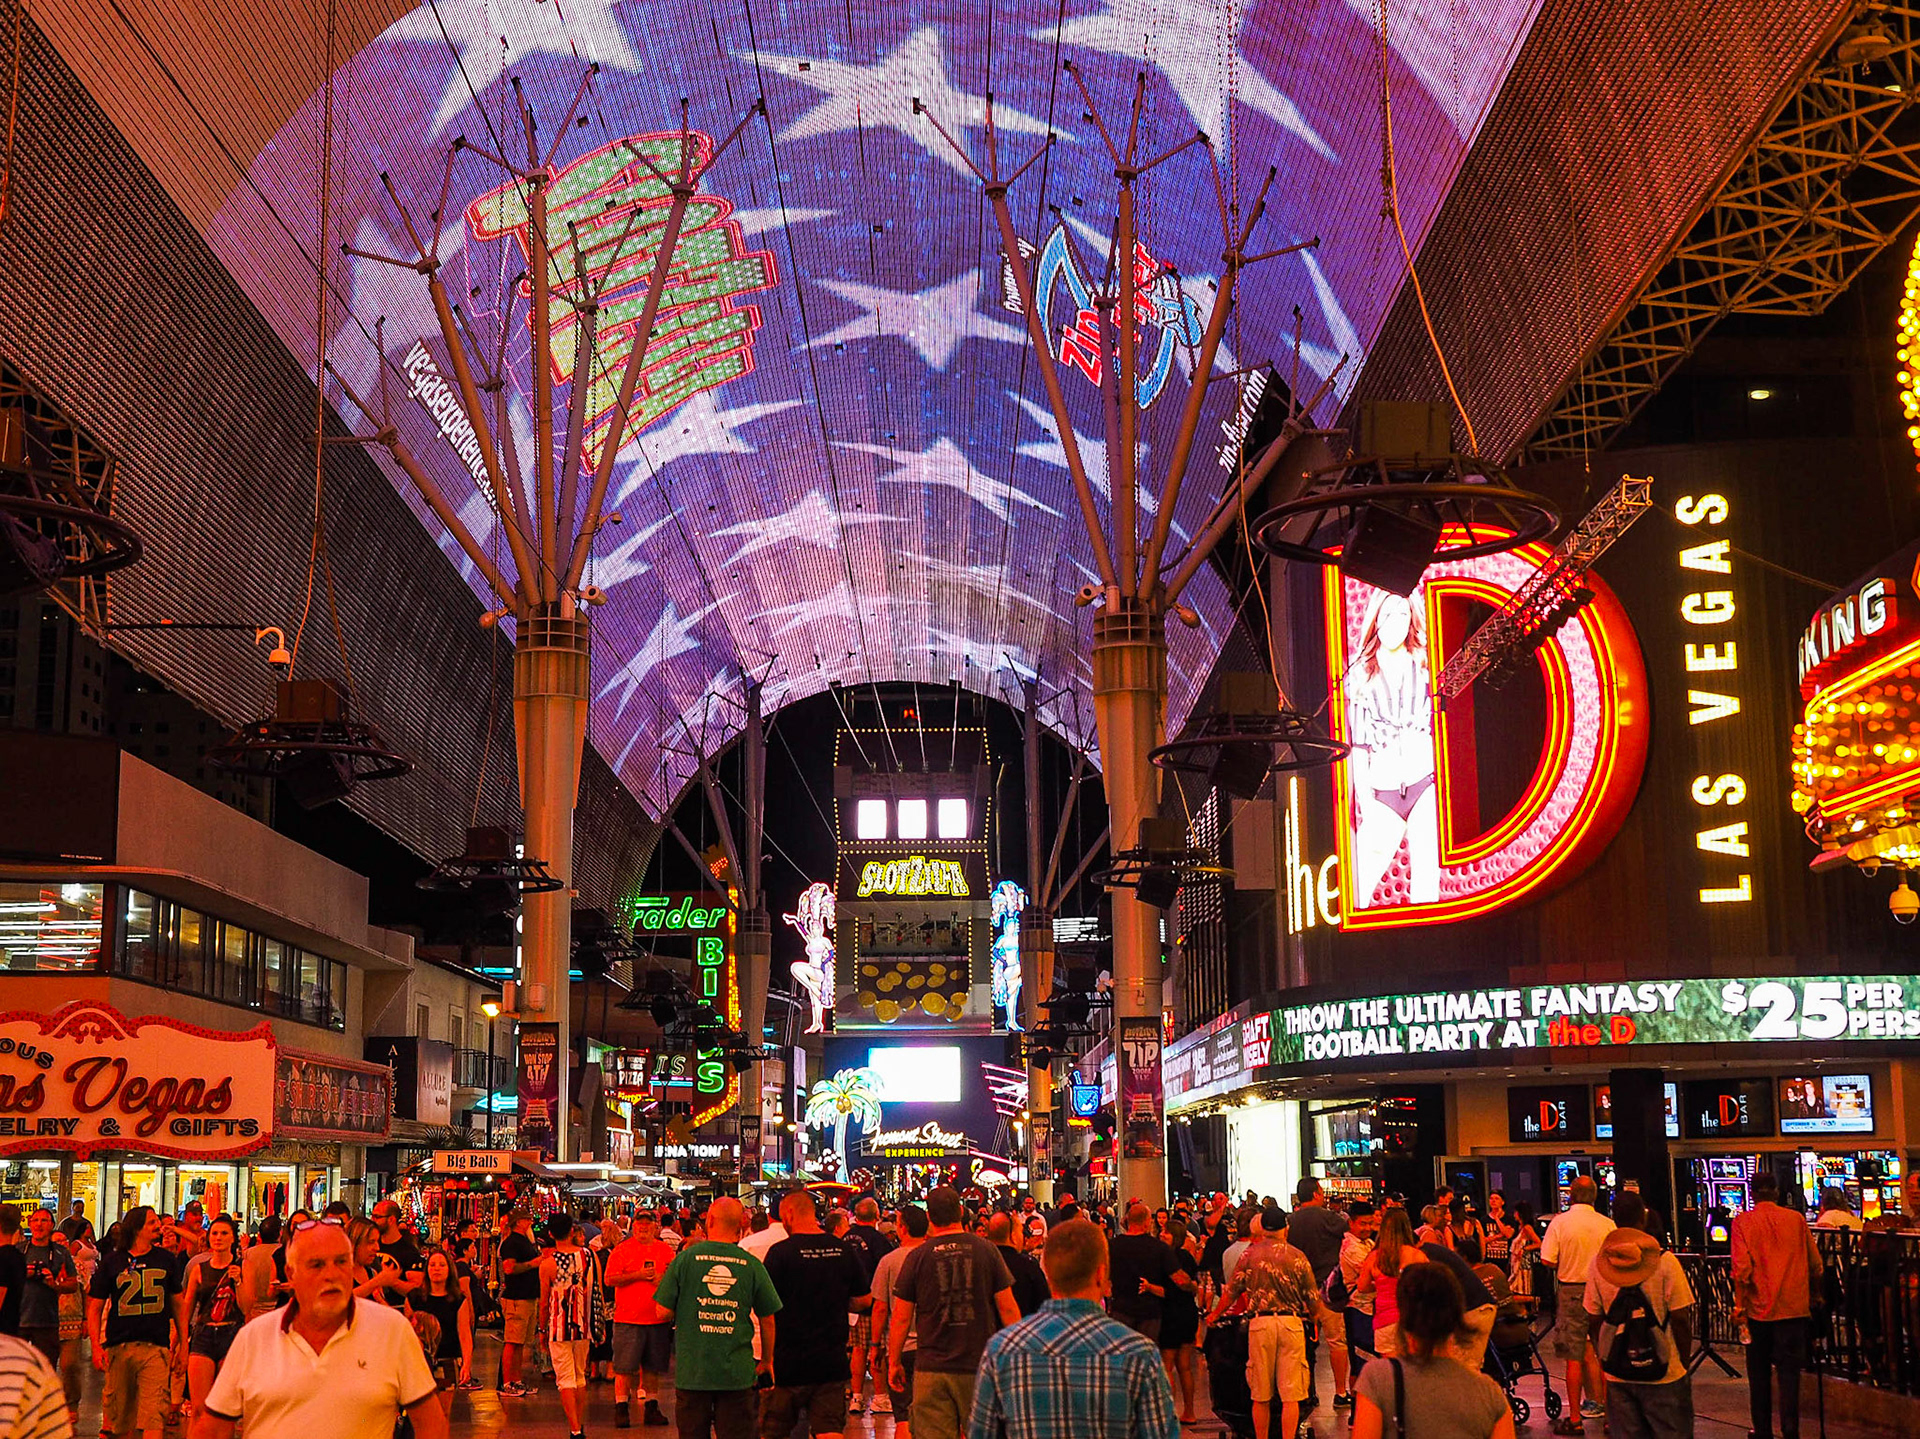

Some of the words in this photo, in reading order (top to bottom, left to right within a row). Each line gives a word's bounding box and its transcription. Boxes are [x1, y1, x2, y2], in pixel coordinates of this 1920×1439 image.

[1675, 493, 1743, 725] VEGAS
[1284, 776, 1341, 935] the
[1322, 521, 1650, 933] D
[1690, 772, 1753, 903] LAS
[1284, 1003, 1345, 1036] THROW
[1349, 1000, 1389, 1027] THE
[1396, 990, 1521, 1024] ULTIMATE
[1531, 982, 1682, 1016] FANTASY
[1721, 981, 1848, 1039] $25
[1847, 982, 1903, 1009] PER
[1304, 1027, 1403, 1060] FOOTBALL
[1409, 1022, 1493, 1052] PARTY
[1502, 1020, 1539, 1048] AT
[1548, 1016, 1601, 1047] the
[1610, 1015, 1637, 1045] D
[63, 1056, 234, 1137] Vegas
[618, 1070, 644, 1087] PIZZA
[98, 1118, 120, 1136] &
[169, 1118, 259, 1136] GIFTS
[1524, 1116, 1540, 1133] the
[1540, 1101, 1559, 1131] D
[1702, 1110, 1719, 1128] the
[1719, 1095, 1739, 1126] D
[1739, 1094, 1747, 1124] BAR
[870, 1127, 921, 1153] Fremont
[918, 1122, 964, 1148] Street
[885, 1148, 945, 1158] EXPERIENCE
[446, 1155, 466, 1169] Big
[470, 1155, 498, 1168] Balls
[115, 1268, 165, 1316] 25
